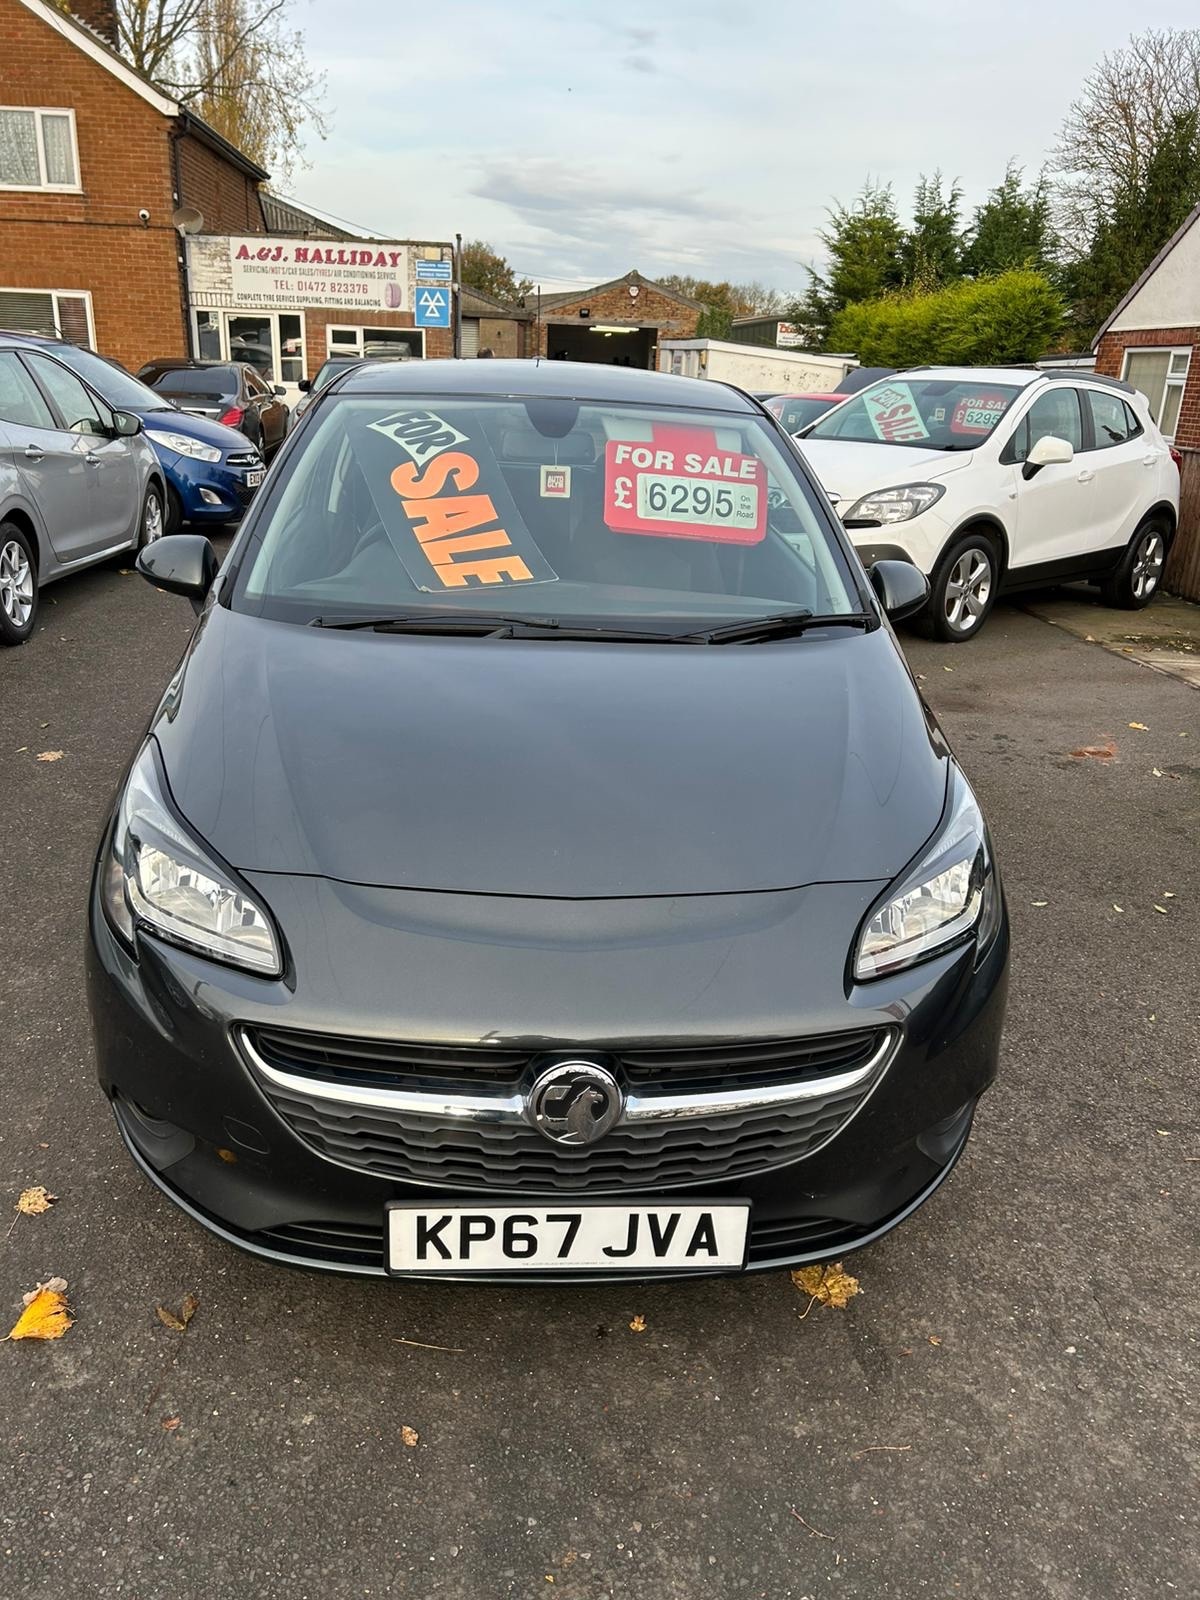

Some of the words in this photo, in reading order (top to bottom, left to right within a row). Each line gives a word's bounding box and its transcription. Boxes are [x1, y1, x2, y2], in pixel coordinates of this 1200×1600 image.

[294, 247, 402, 267] HALLIDAY
[343, 269, 376, 279] CONDITIONING
[377, 271, 397, 280] SERVICE
[274, 280, 294, 291] TEL:
[297, 281, 326, 292] 01472
[330, 282, 368, 294] 823376
[237, 293, 261, 301] COMPLETE
[262, 293, 275, 302] TYRE
[275, 294, 295, 303] SERVICE
[324, 296, 343, 305] FITTING
[354, 298, 381, 306] BALANCING
[960, 398, 984, 407] FOR
[875, 403, 924, 442] SALE
[955, 410, 965, 424] £
[376, 411, 456, 455] FOR
[615, 444, 674, 470] FOR
[684, 453, 758, 479] SALE
[614, 476, 633, 509] £
[649, 482, 733, 518] 6295
[391, 452, 534, 587] SALE
[736, 510, 754, 519] Road
[416, 1214, 583, 1259] KP67
[602, 1213, 719, 1257] JVA
